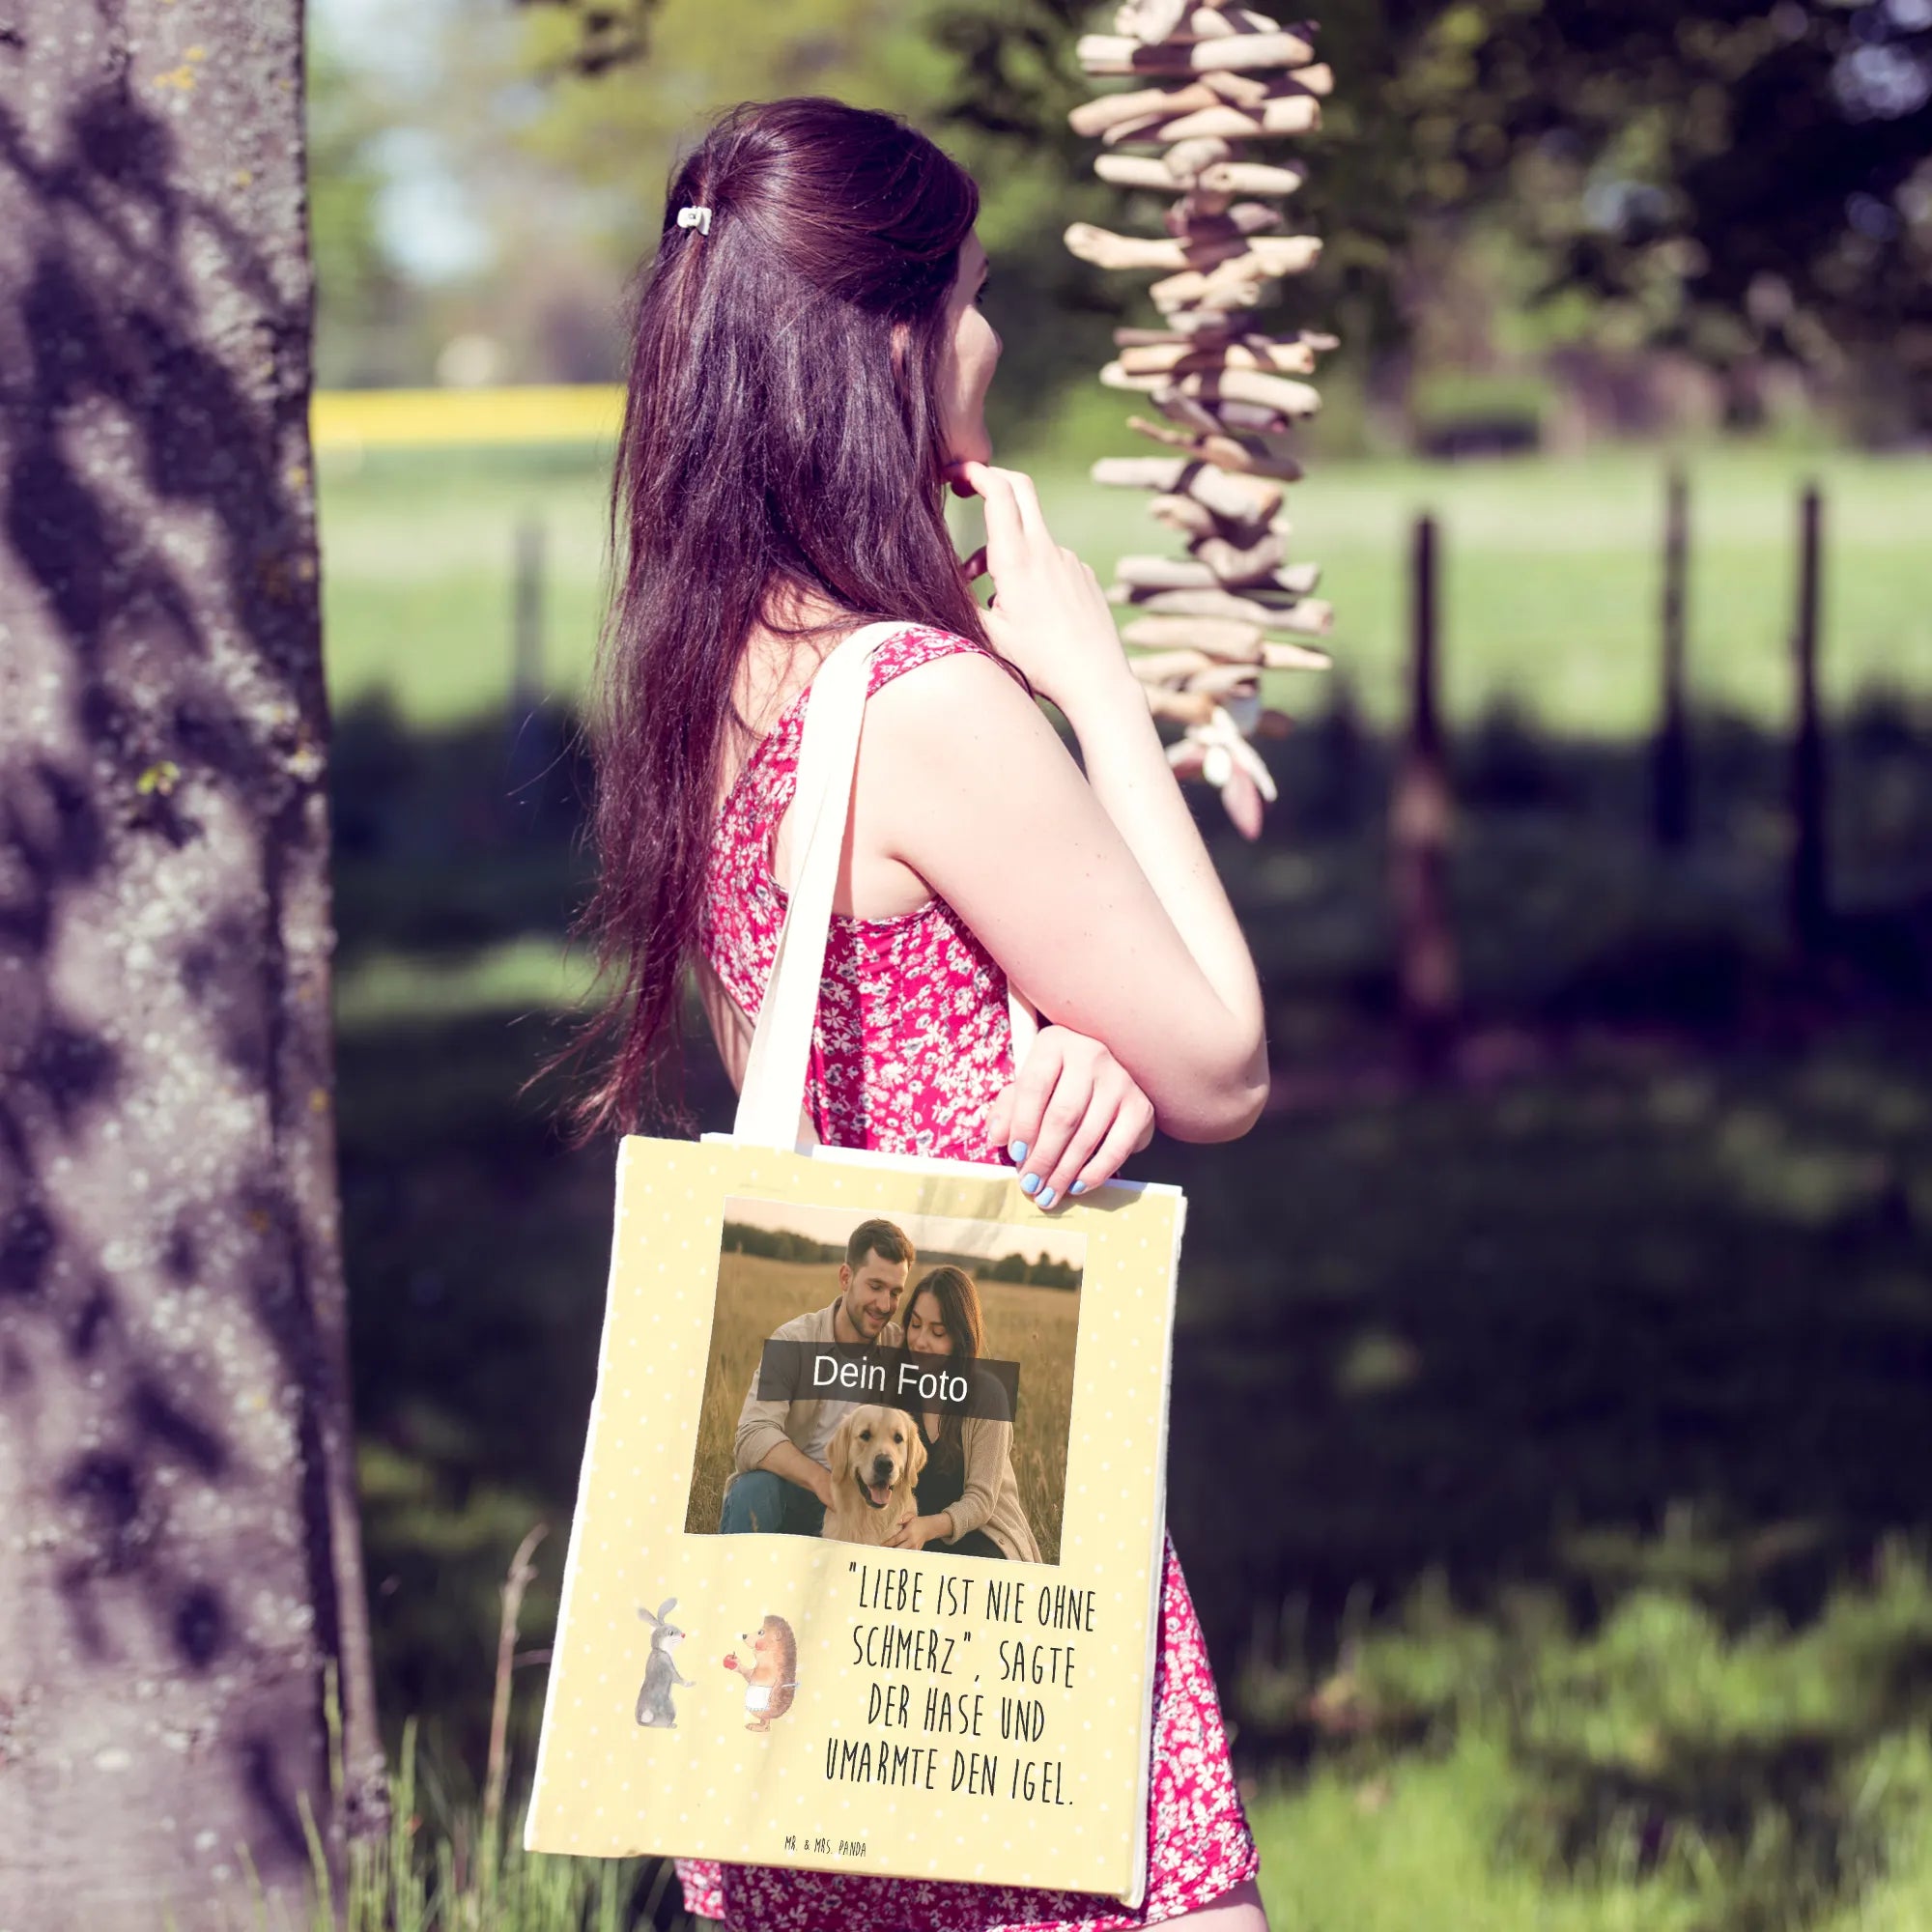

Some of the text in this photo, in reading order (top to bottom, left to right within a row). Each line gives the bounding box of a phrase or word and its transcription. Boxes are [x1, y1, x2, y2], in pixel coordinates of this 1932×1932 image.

[813, 1355, 968, 1402] Dein Foto
[848, 1561, 1096, 1632] "LIEBE IST NIE OHNE
[999, 1640, 1075, 1689] SAGTE
[868, 1683, 1044, 1743] DER HASE UND
[826, 1737, 1073, 1805] UMARMTE DEN IGEL.
[784, 1835, 866, 1857] MR. & MRS. PANDA
